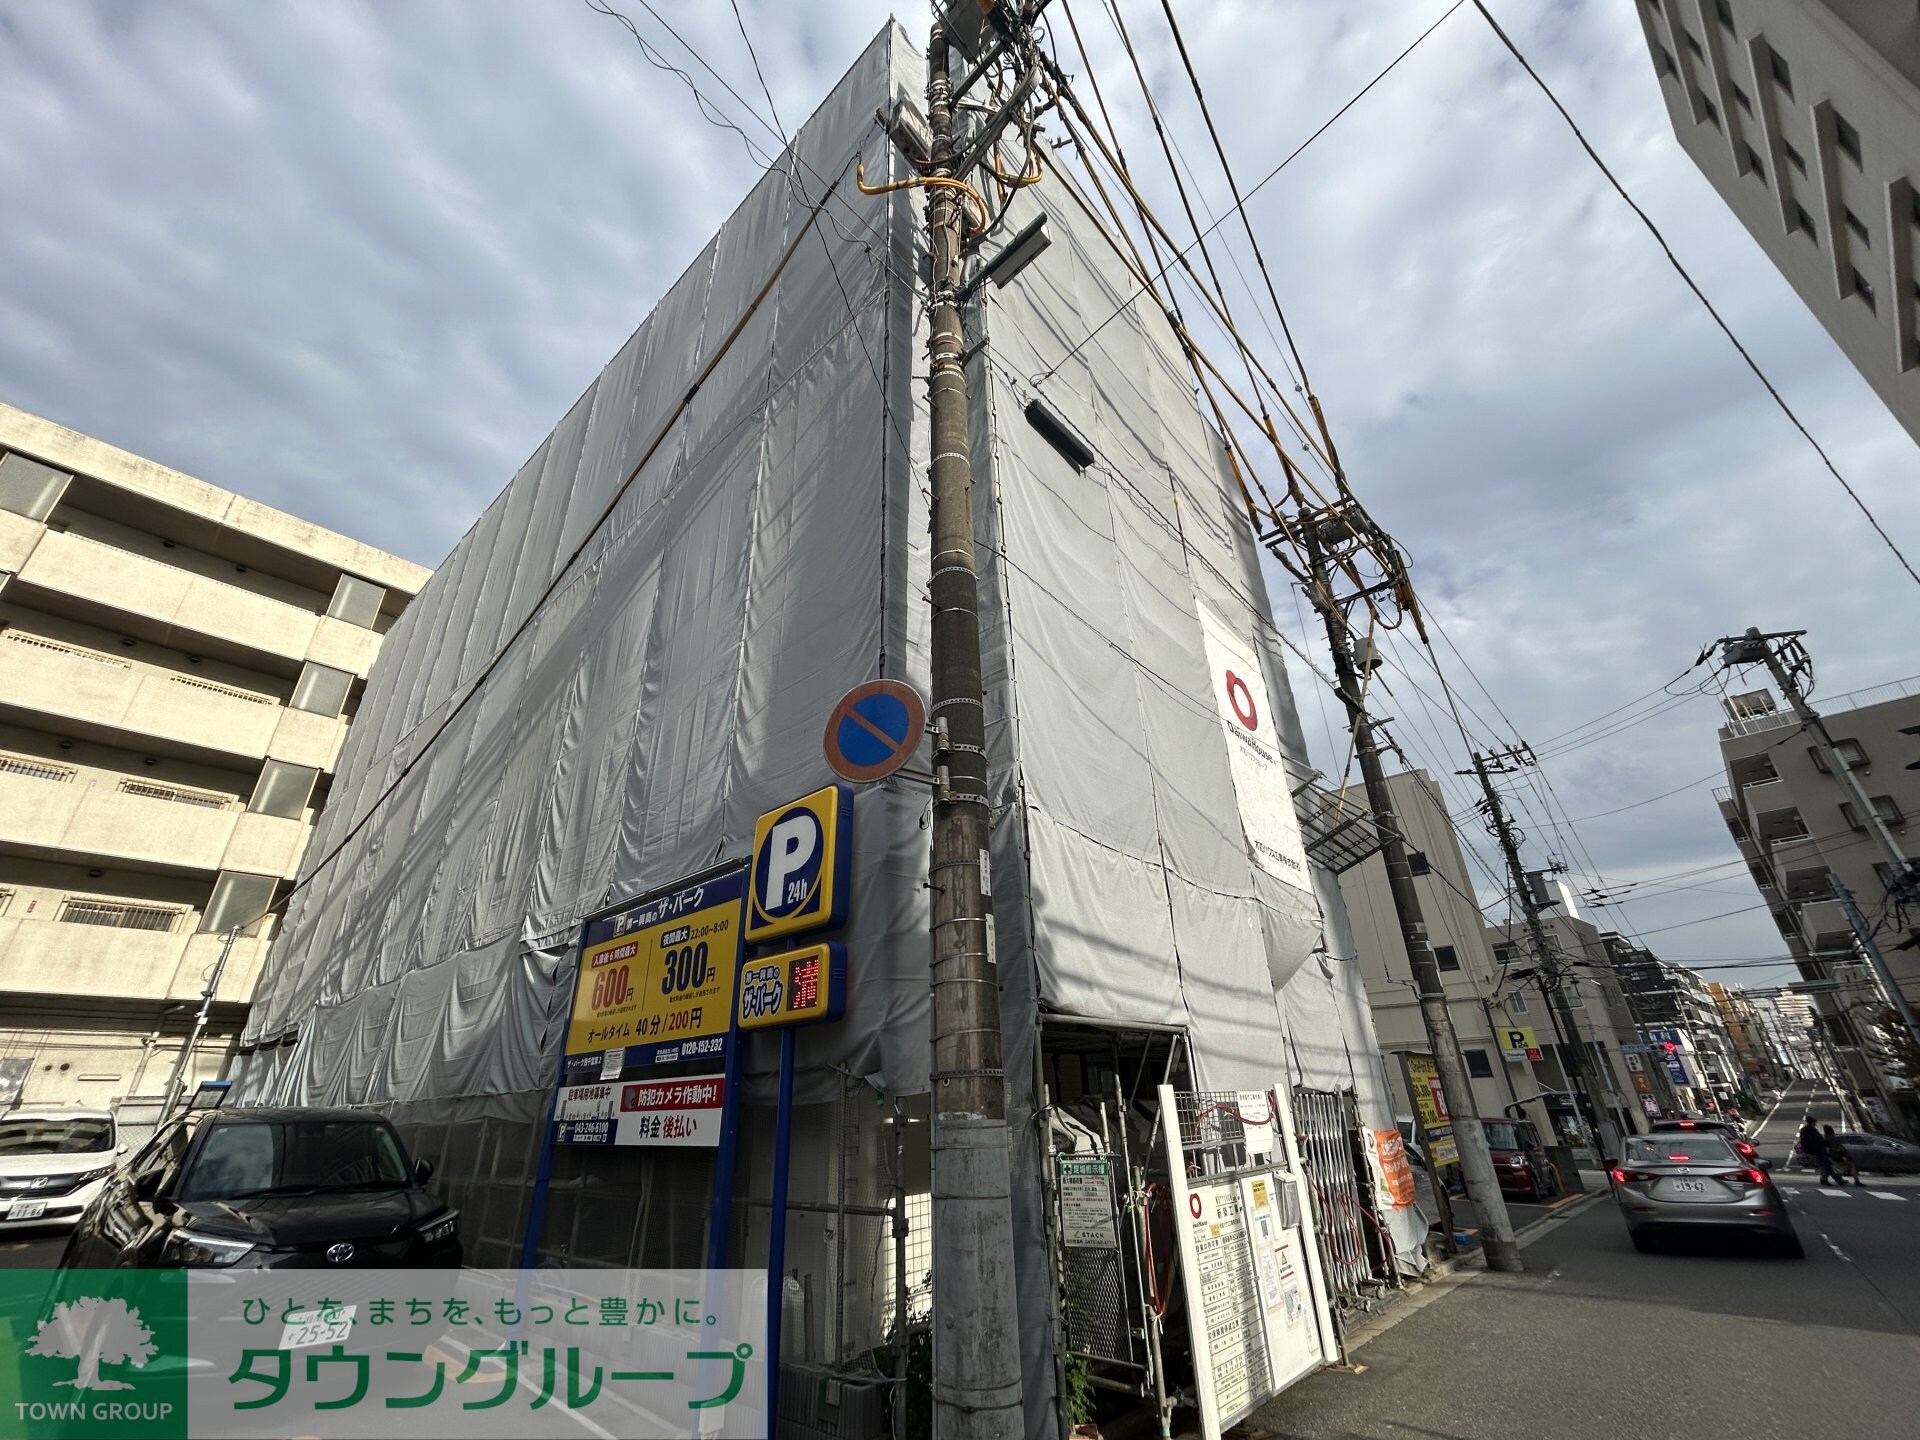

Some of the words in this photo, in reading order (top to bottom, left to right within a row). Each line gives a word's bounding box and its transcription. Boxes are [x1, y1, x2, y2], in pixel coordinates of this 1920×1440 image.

[765, 815, 817, 911] P
[787, 880, 808, 904] 24h
[681, 1037, 723, 1056] 0120-152-232
[1508, 1031, 1525, 1048] P
[638, 1084, 717, 1107] 防犯カメラ作動中!
[296, 1321, 349, 1345] 25-52
